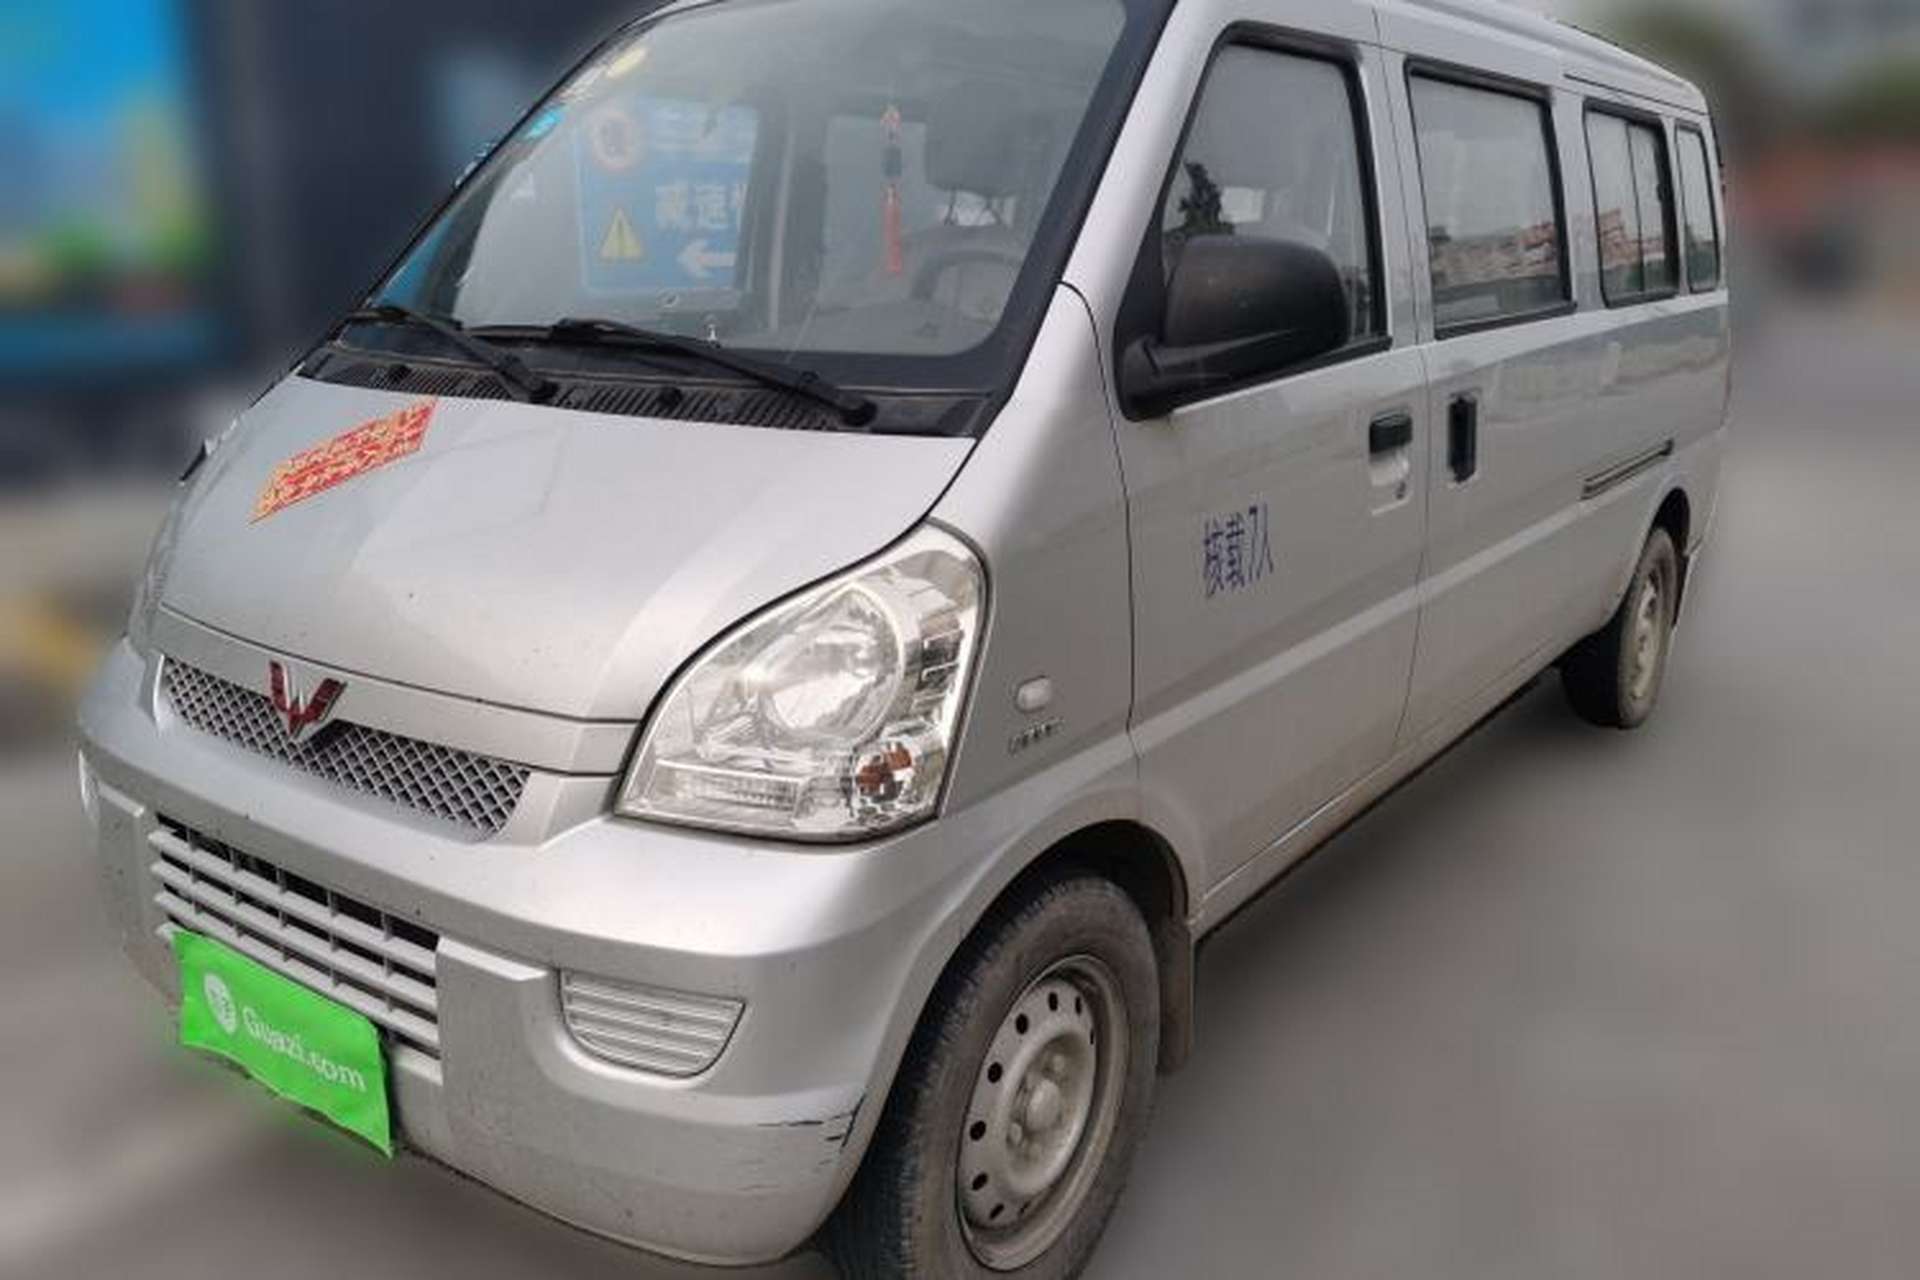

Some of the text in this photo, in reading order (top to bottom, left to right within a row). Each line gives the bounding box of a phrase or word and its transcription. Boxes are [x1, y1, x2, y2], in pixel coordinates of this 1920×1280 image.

[1202, 502, 1274, 598] 核载7人
[242, 1005, 367, 1093] Guazi.com
